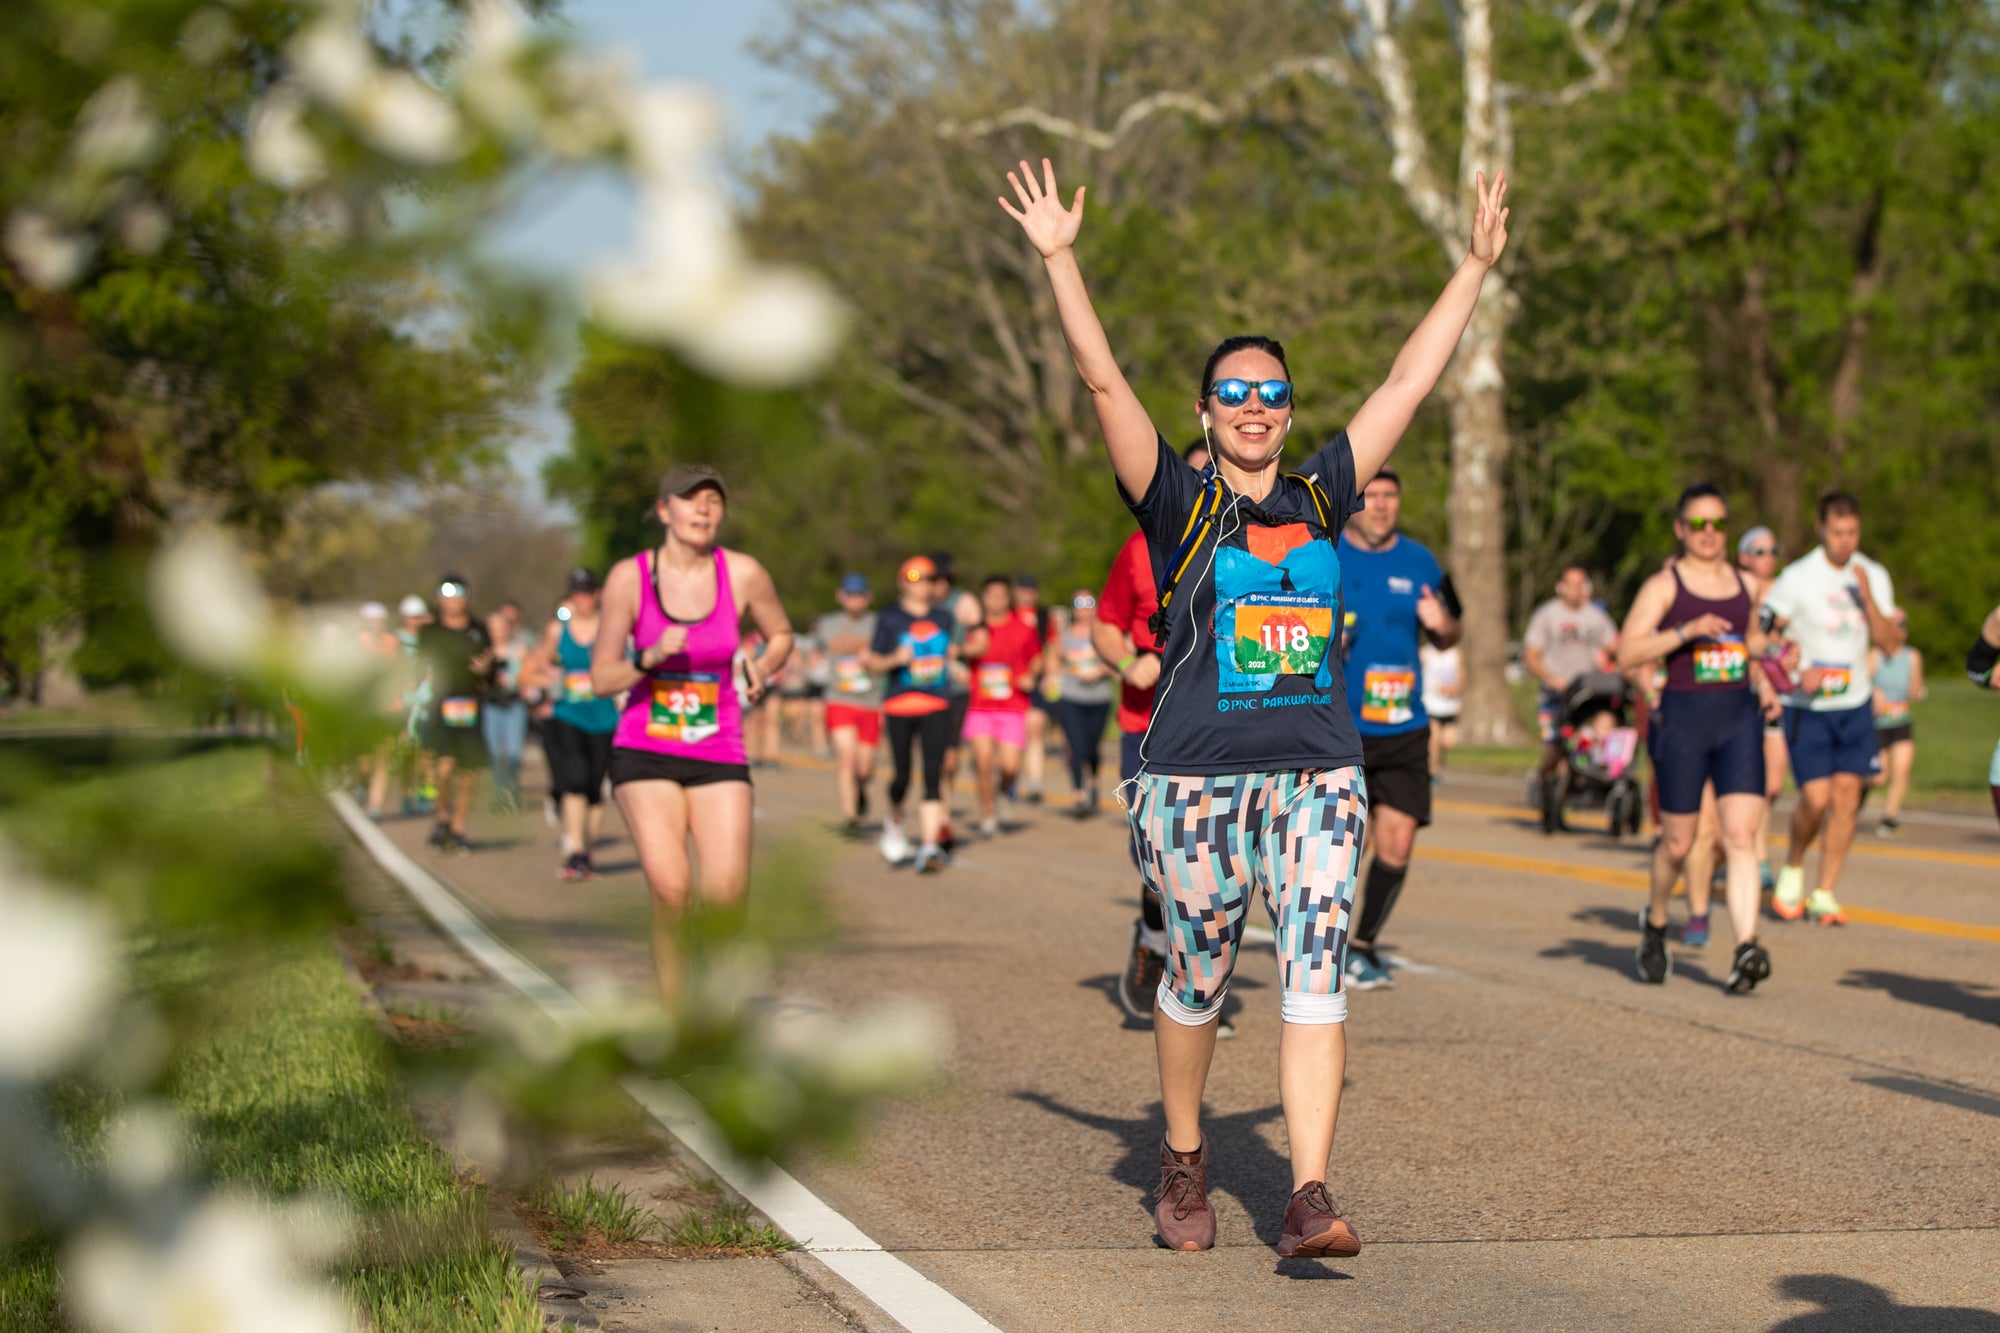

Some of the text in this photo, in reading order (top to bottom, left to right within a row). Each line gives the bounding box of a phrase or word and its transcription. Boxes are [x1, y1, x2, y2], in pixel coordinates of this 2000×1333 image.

[1262, 625, 1310, 652] 118
[1248, 661, 1266, 669] 2022
[668, 691, 701, 715] 23
[1231, 698, 1258, 710] PNC
[1262, 694, 1312, 708] PARKWAY
